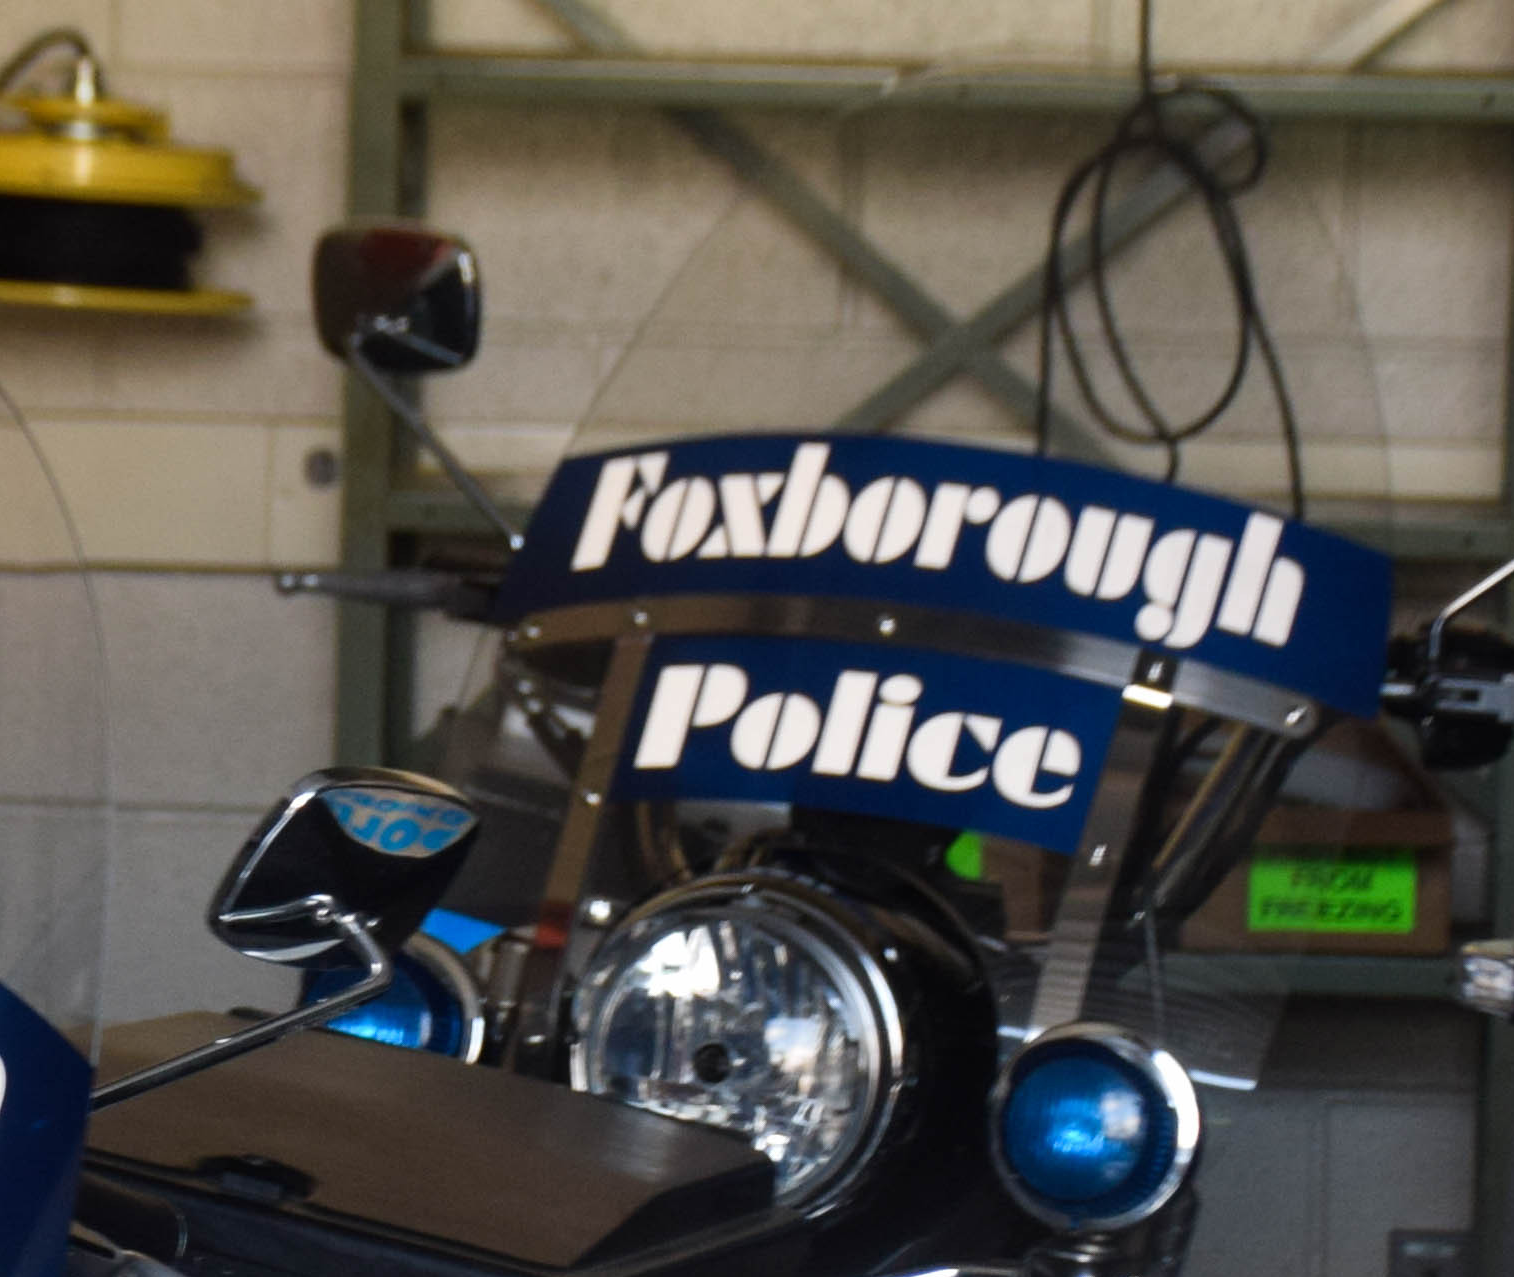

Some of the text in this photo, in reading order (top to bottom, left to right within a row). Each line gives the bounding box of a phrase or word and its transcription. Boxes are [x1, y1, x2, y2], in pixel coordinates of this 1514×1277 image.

[571, 442, 1307, 649] Foxborough
[634, 664, 1081, 808] Police
[1260, 898, 1403, 924] FREEZING
